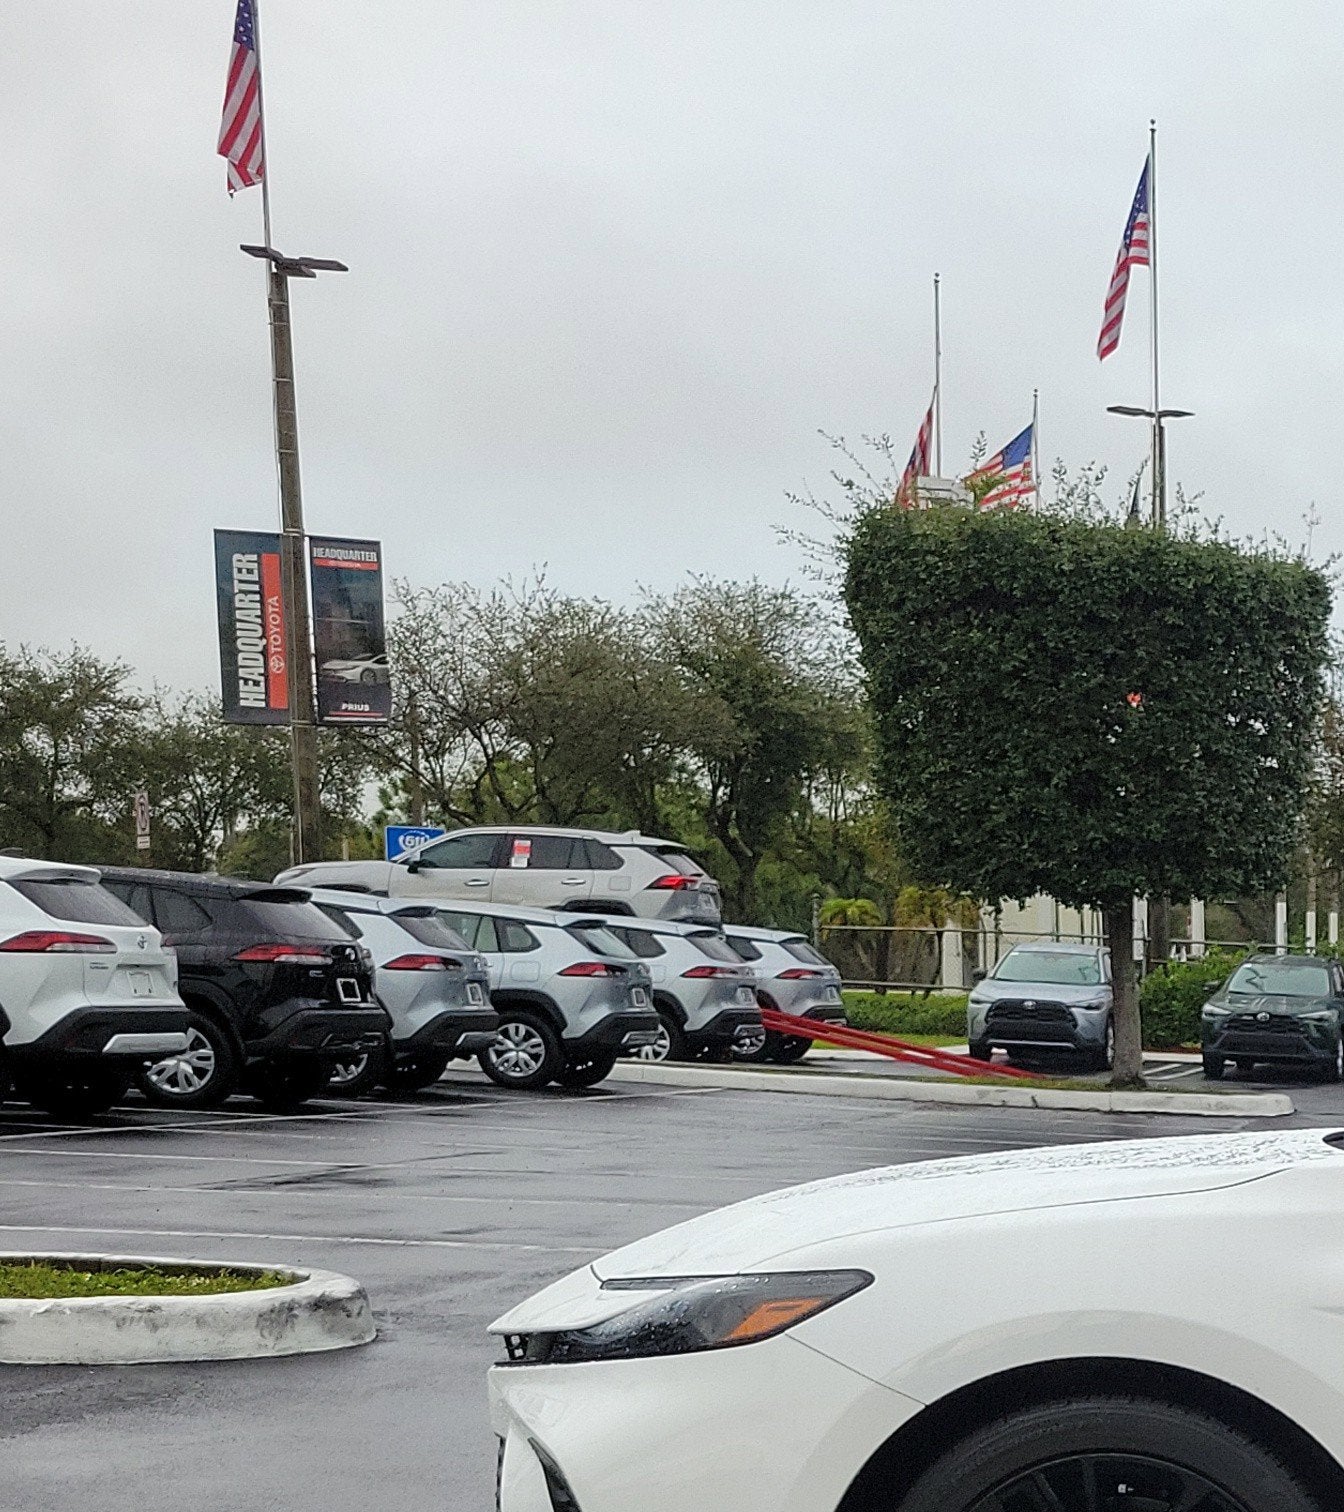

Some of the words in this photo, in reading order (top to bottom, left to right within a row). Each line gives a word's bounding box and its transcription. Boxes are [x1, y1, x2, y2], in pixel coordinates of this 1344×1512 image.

[313, 547, 377, 562] HEADQUARTER
[232, 552, 266, 708] HEADQUARTER
[267, 596, 283, 654] TOYOTA
[341, 703, 370, 712] PRIUS
